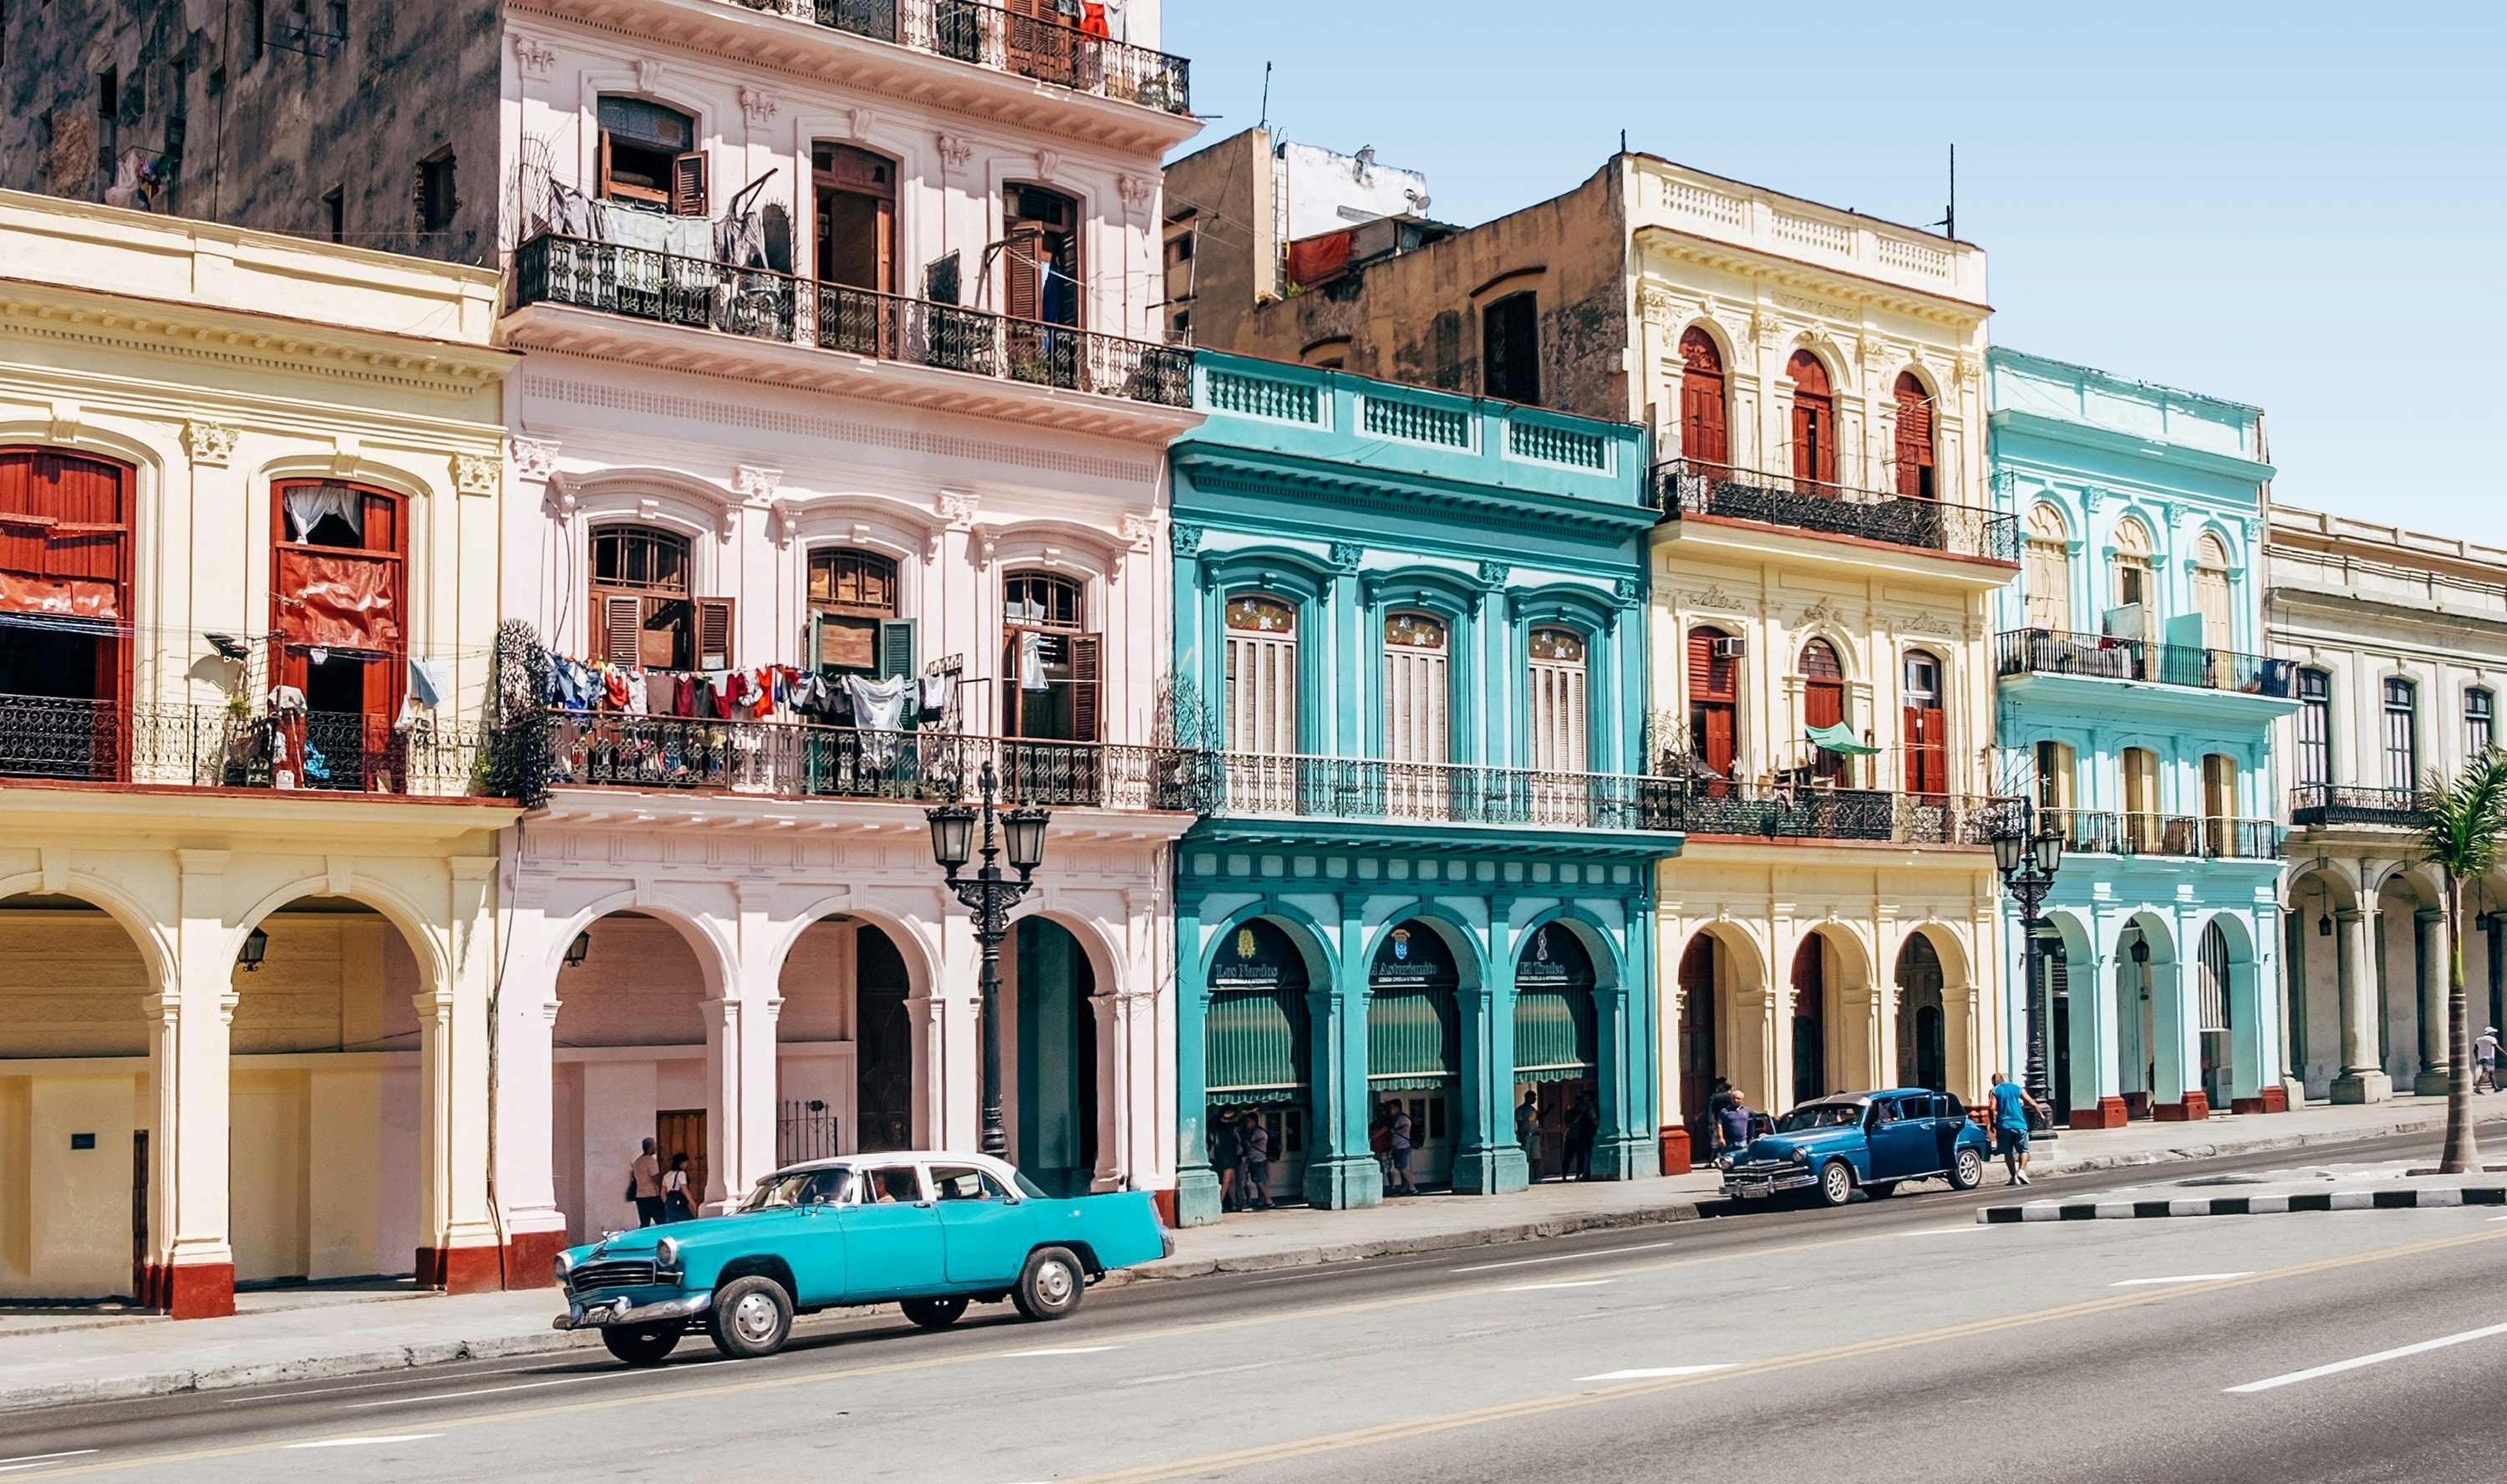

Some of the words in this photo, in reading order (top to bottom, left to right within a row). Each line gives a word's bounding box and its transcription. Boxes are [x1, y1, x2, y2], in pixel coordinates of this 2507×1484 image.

[1216, 964, 1237, 978] Los
[1238, 963, 1278, 978] Nardos
[1520, 962, 1532, 975] El
